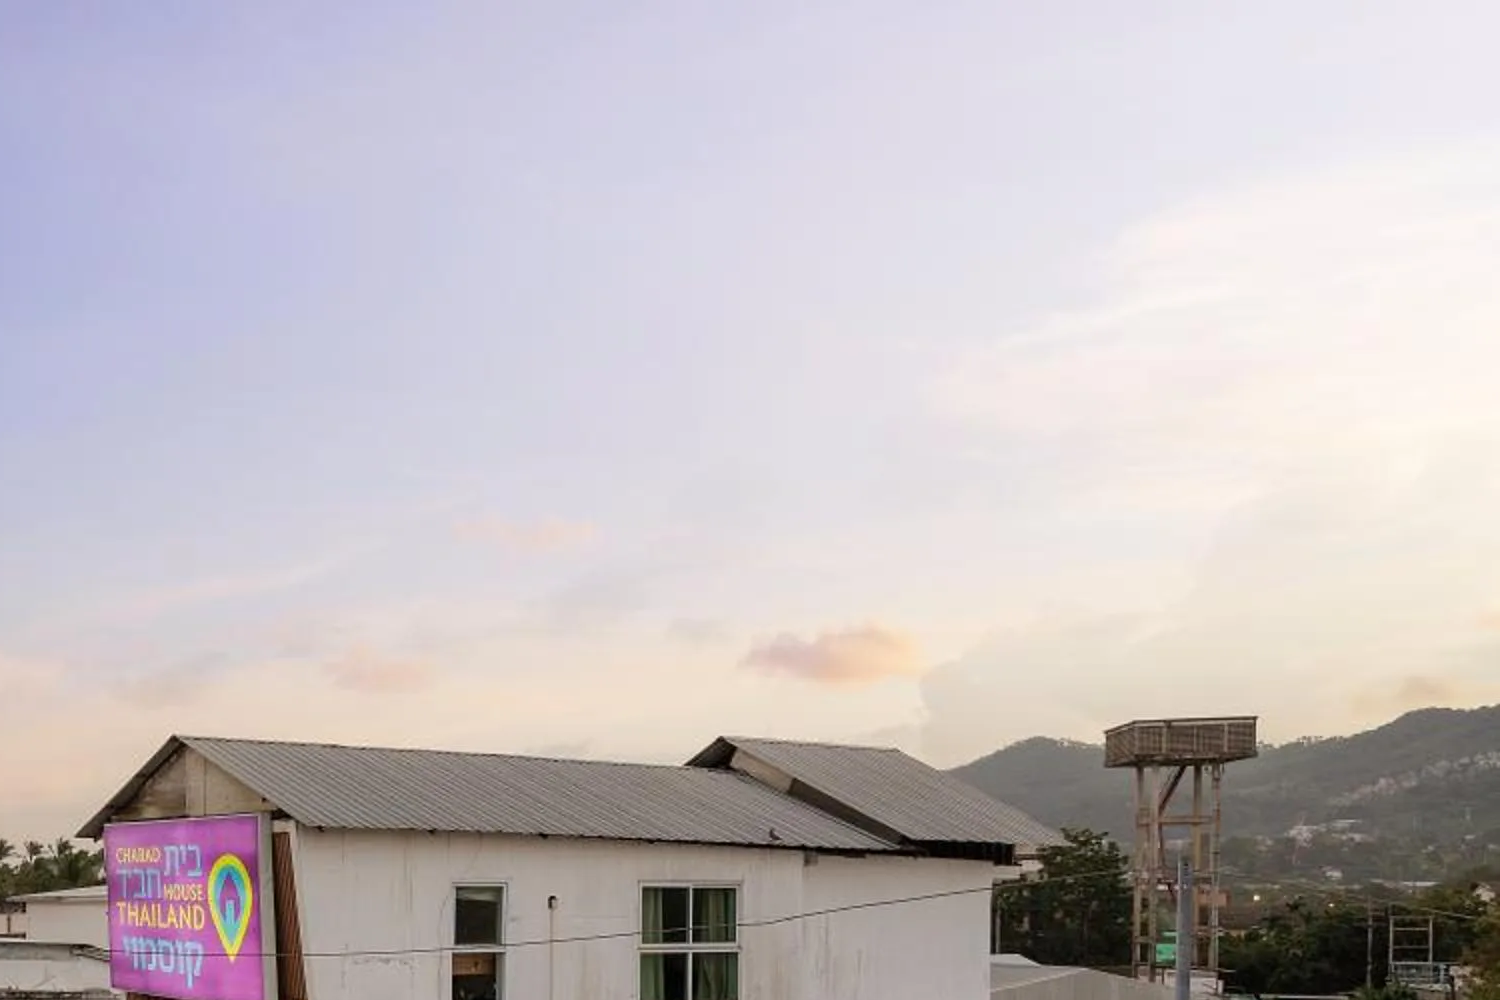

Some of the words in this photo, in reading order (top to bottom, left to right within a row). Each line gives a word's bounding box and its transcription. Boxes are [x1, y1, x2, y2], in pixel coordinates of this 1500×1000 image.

[115, 847, 162, 864] CHABAD
[163, 844, 203, 878] בית
[163, 883, 205, 902] HOUSE
[116, 901, 205, 931] THAILAND
